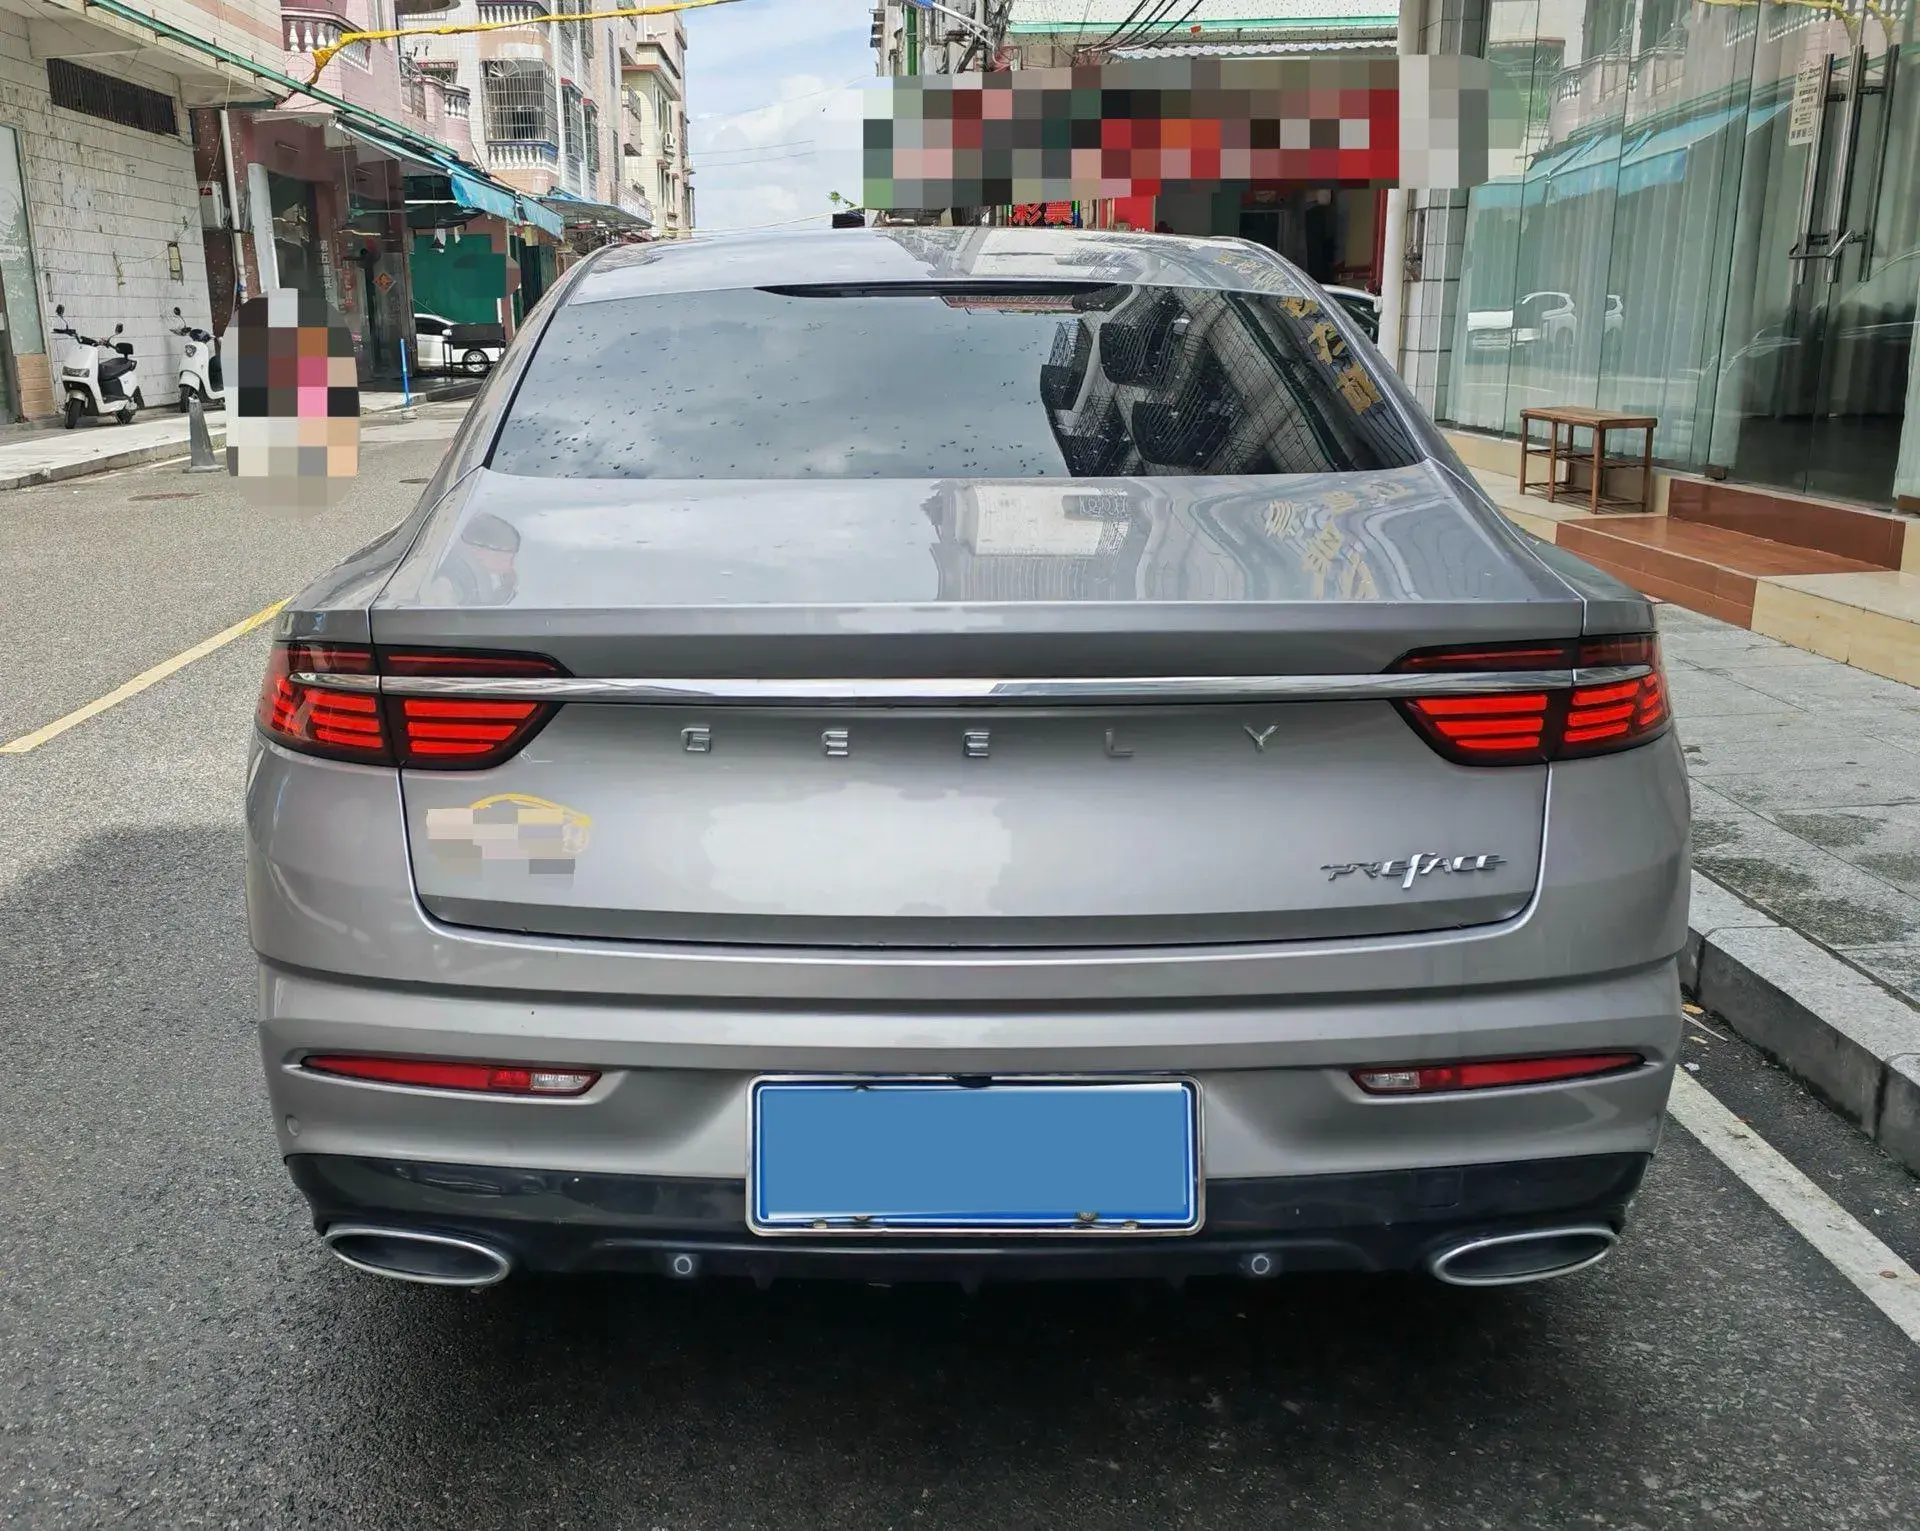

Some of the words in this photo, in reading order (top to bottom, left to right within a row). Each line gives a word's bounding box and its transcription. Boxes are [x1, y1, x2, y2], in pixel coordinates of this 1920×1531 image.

[1012, 200, 1074, 225] 彩票
[681, 722, 1279, 757] GEELY
[1320, 852, 1508, 889] PREFACE
